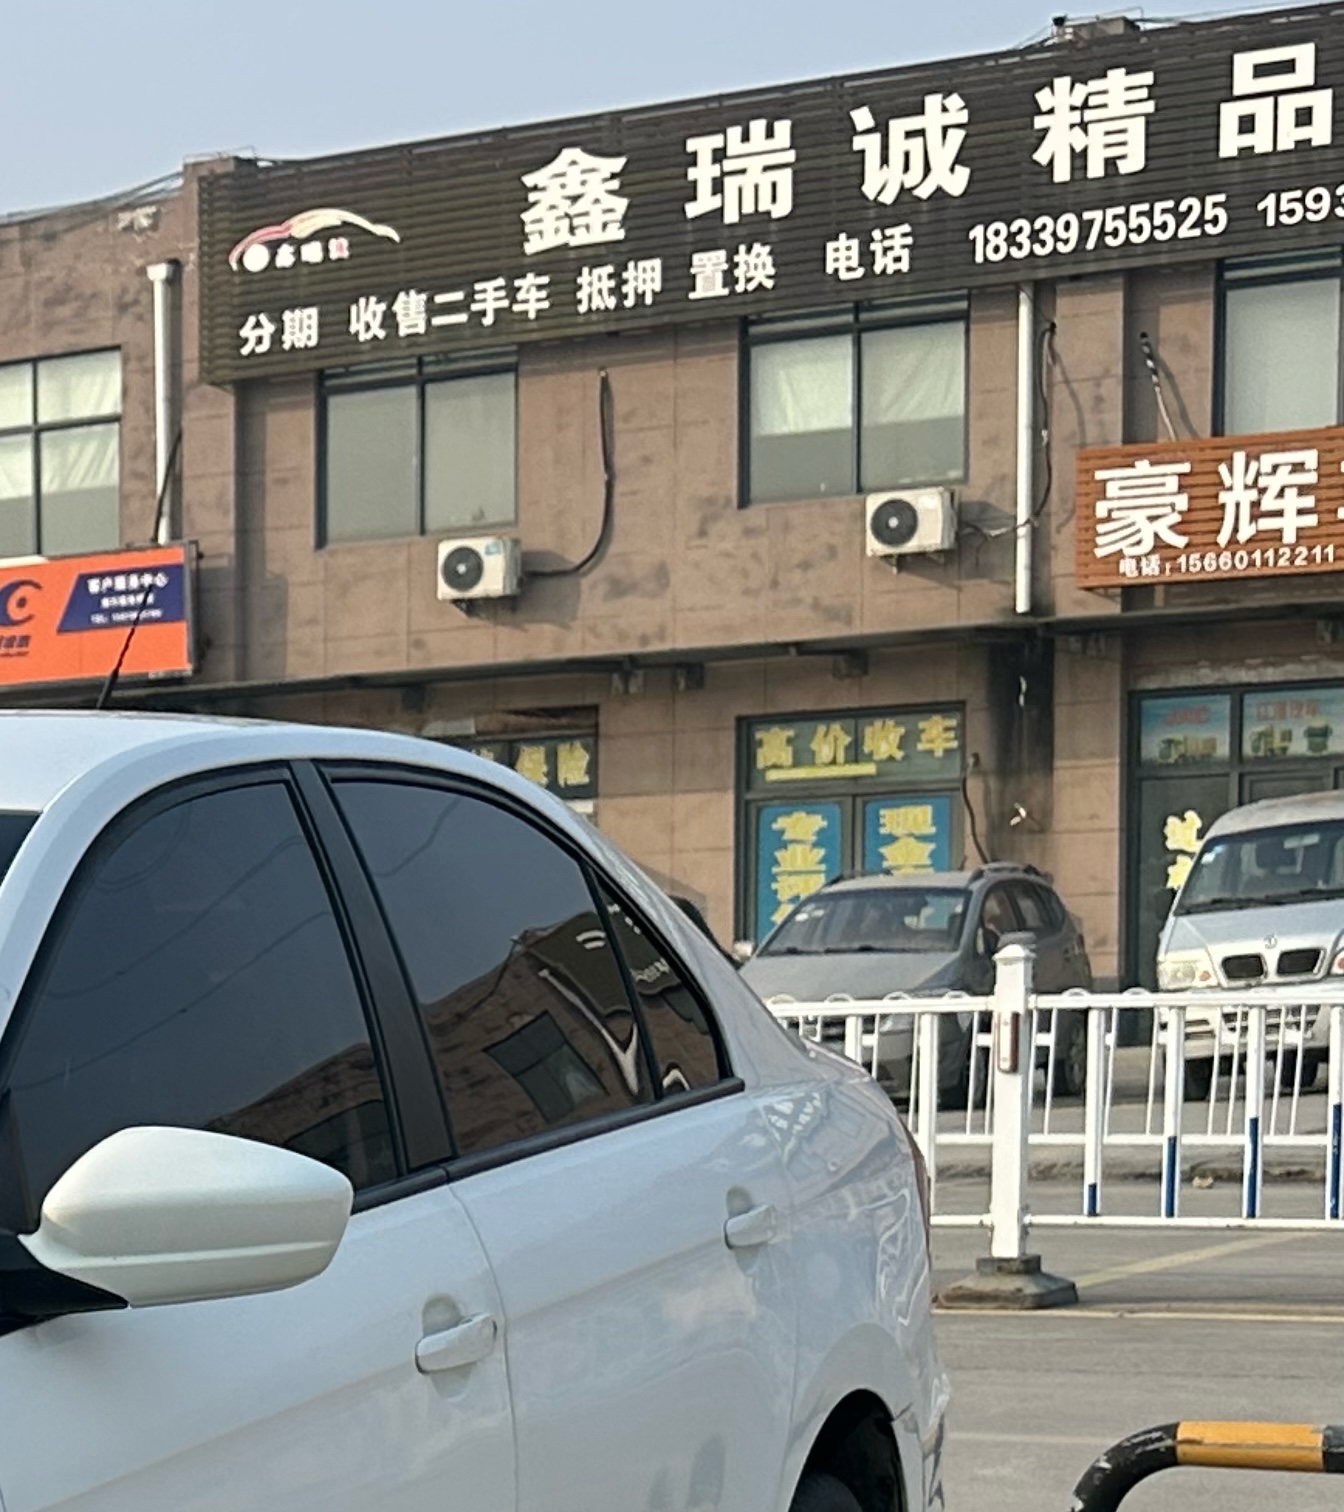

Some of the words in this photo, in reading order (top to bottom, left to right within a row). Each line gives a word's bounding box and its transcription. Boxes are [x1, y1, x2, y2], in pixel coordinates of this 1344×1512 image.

[520, 42, 1333, 256] 鑫瑞诚精品
[240, 308, 320, 356] 分期
[349, 273, 551, 342] 收售二手车
[576, 257, 663, 314] 抵押
[688, 243, 777, 299] 置换
[825, 223, 913, 281] 电话
[968, 193, 1229, 264] 18339755525
[1094, 448, 1344, 559] 豪辉
[754, 713, 961, 770] 高价收车
[879, 804, 937, 875] 现金
